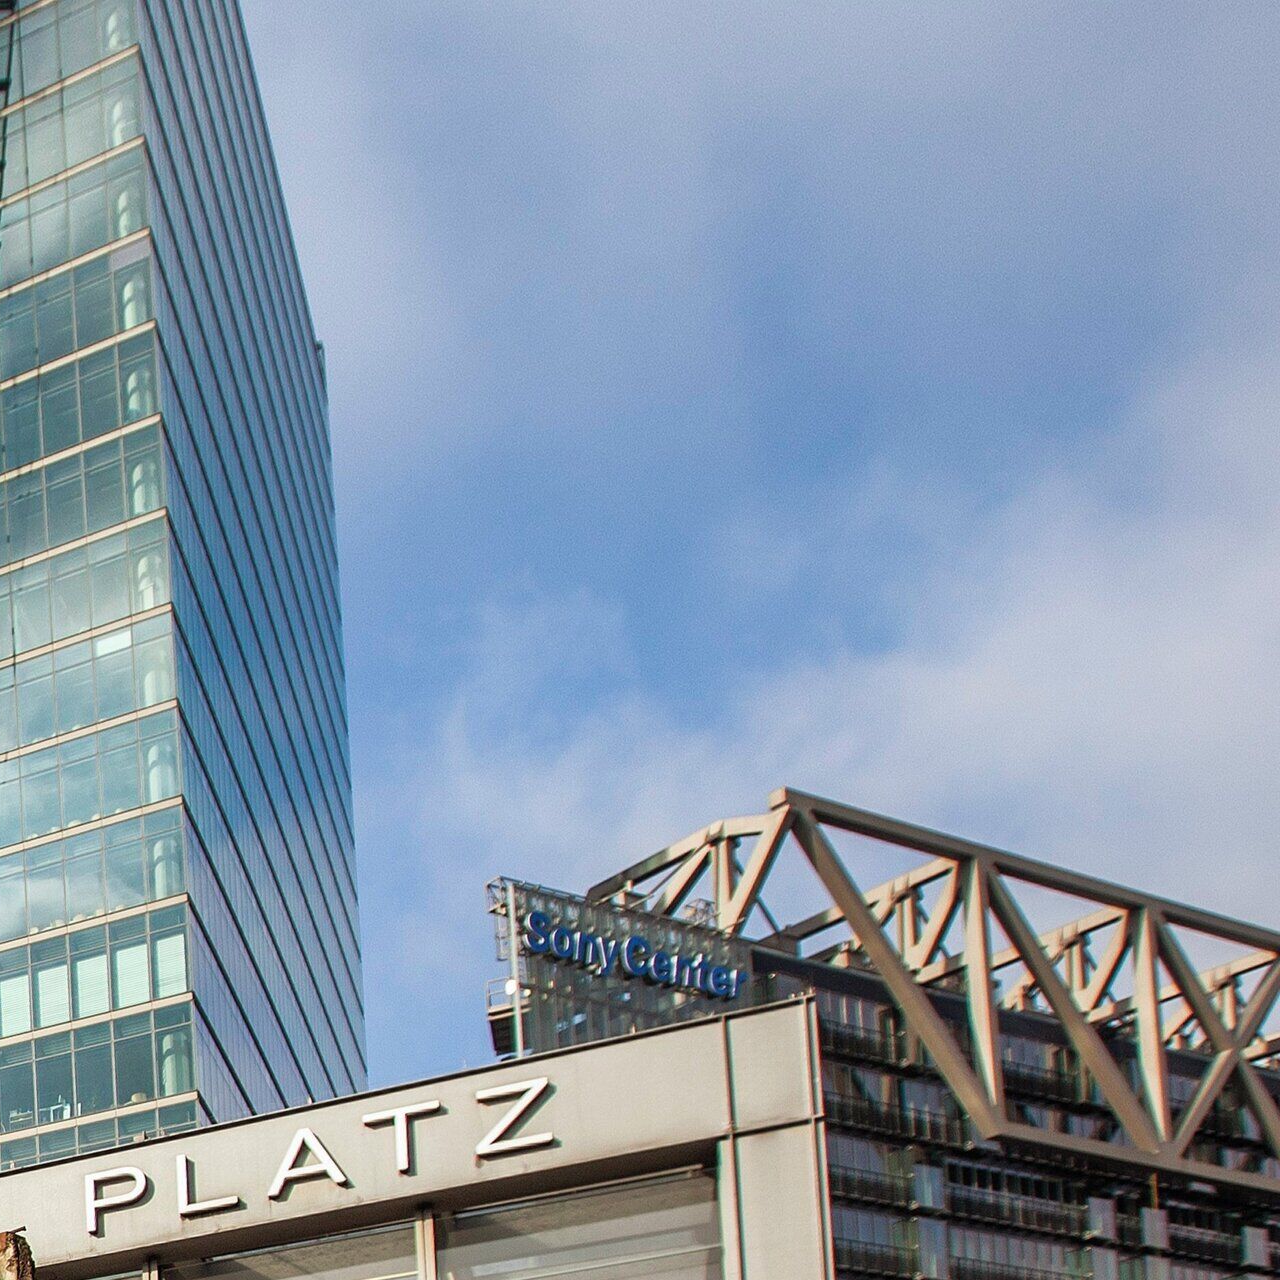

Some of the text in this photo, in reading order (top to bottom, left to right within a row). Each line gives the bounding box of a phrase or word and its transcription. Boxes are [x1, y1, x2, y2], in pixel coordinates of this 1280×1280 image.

[523, 911, 749, 998] Sony Center
[84, 1076, 561, 1238] PLATZ
